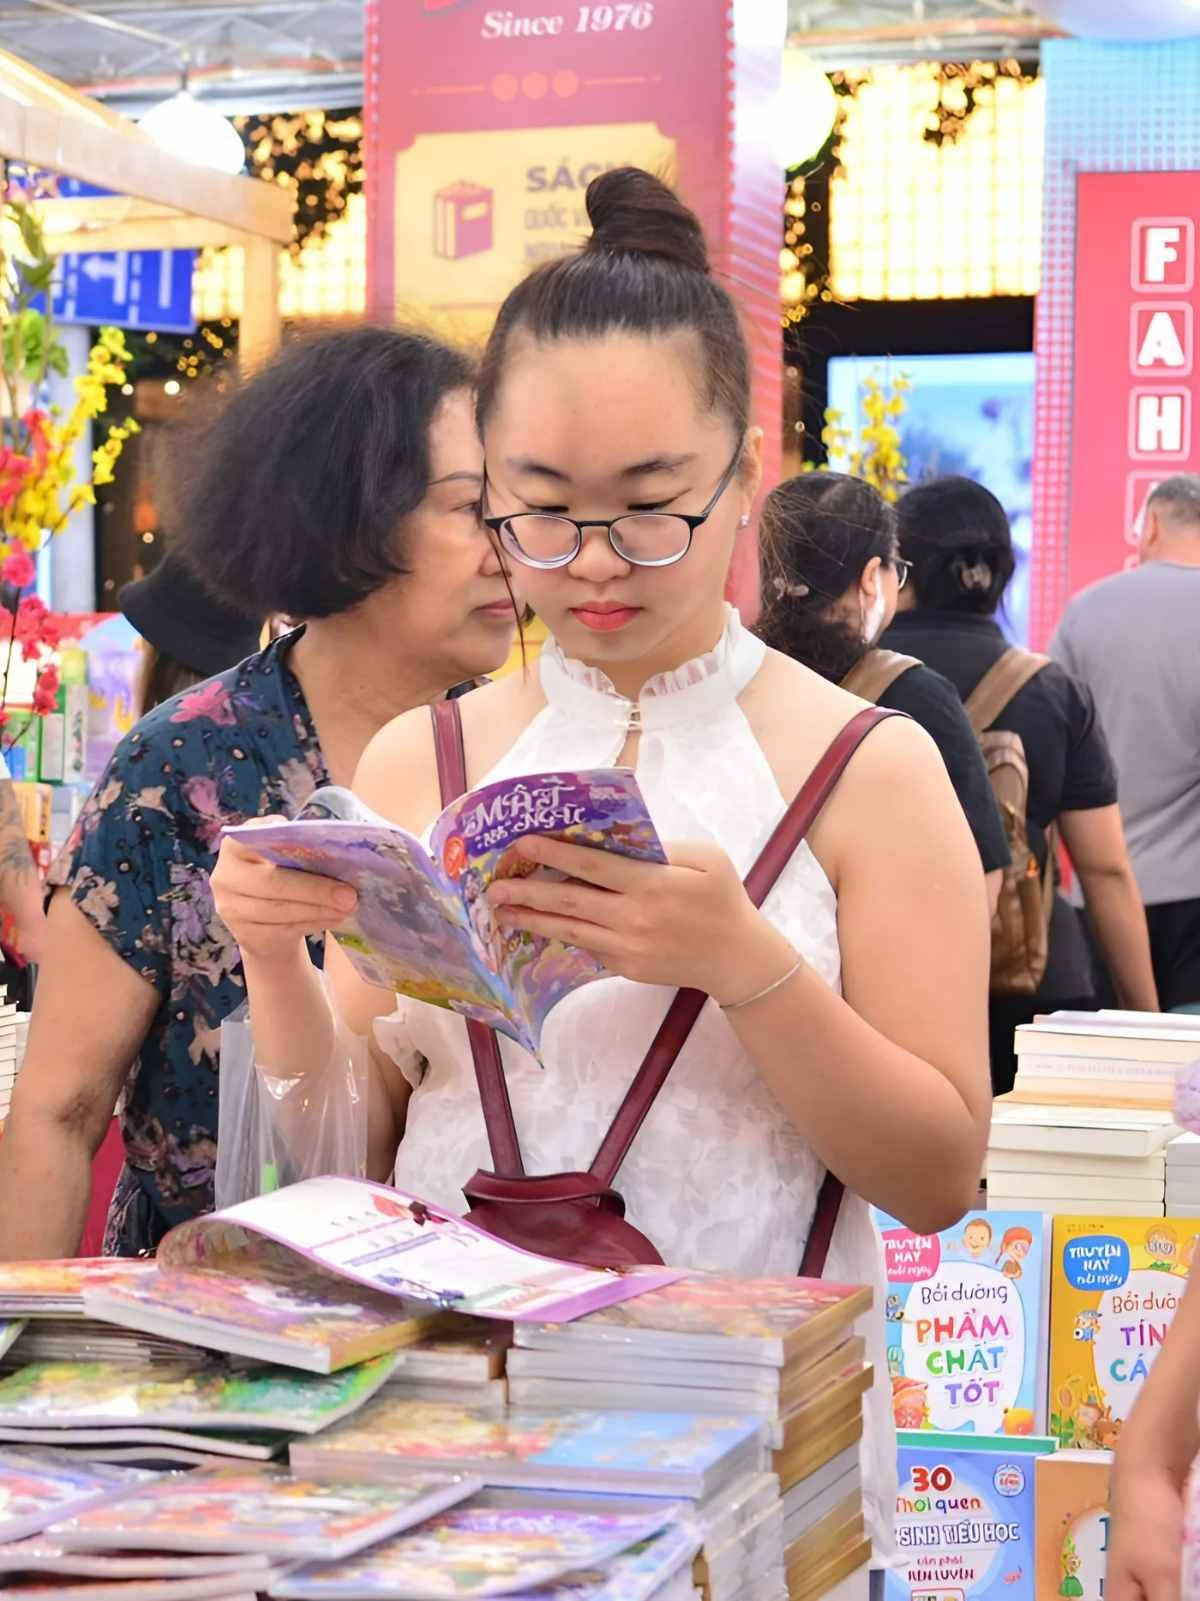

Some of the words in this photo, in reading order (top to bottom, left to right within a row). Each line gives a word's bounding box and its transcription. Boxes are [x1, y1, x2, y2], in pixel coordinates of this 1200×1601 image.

[480, 10, 564, 39] Since
[575, 3, 655, 34] 1976
[526, 155, 632, 192] SÁC
[1133, 228, 1185, 536] FAH
[895, 1250, 920, 1262] HAY
[1084, 1258, 1110, 1270] HAY
[916, 1308, 1009, 1343] PHẨM
[1120, 1318, 1168, 1346] TÍN
[926, 1341, 1004, 1374] CHẤT
[1110, 1353, 1148, 1382] CÁ
[945, 1377, 1000, 1405] TỐT
[912, 1467, 952, 1492] 30
[935, 1497, 981, 1514] quen
[900, 1526, 940, 1546] SINH
